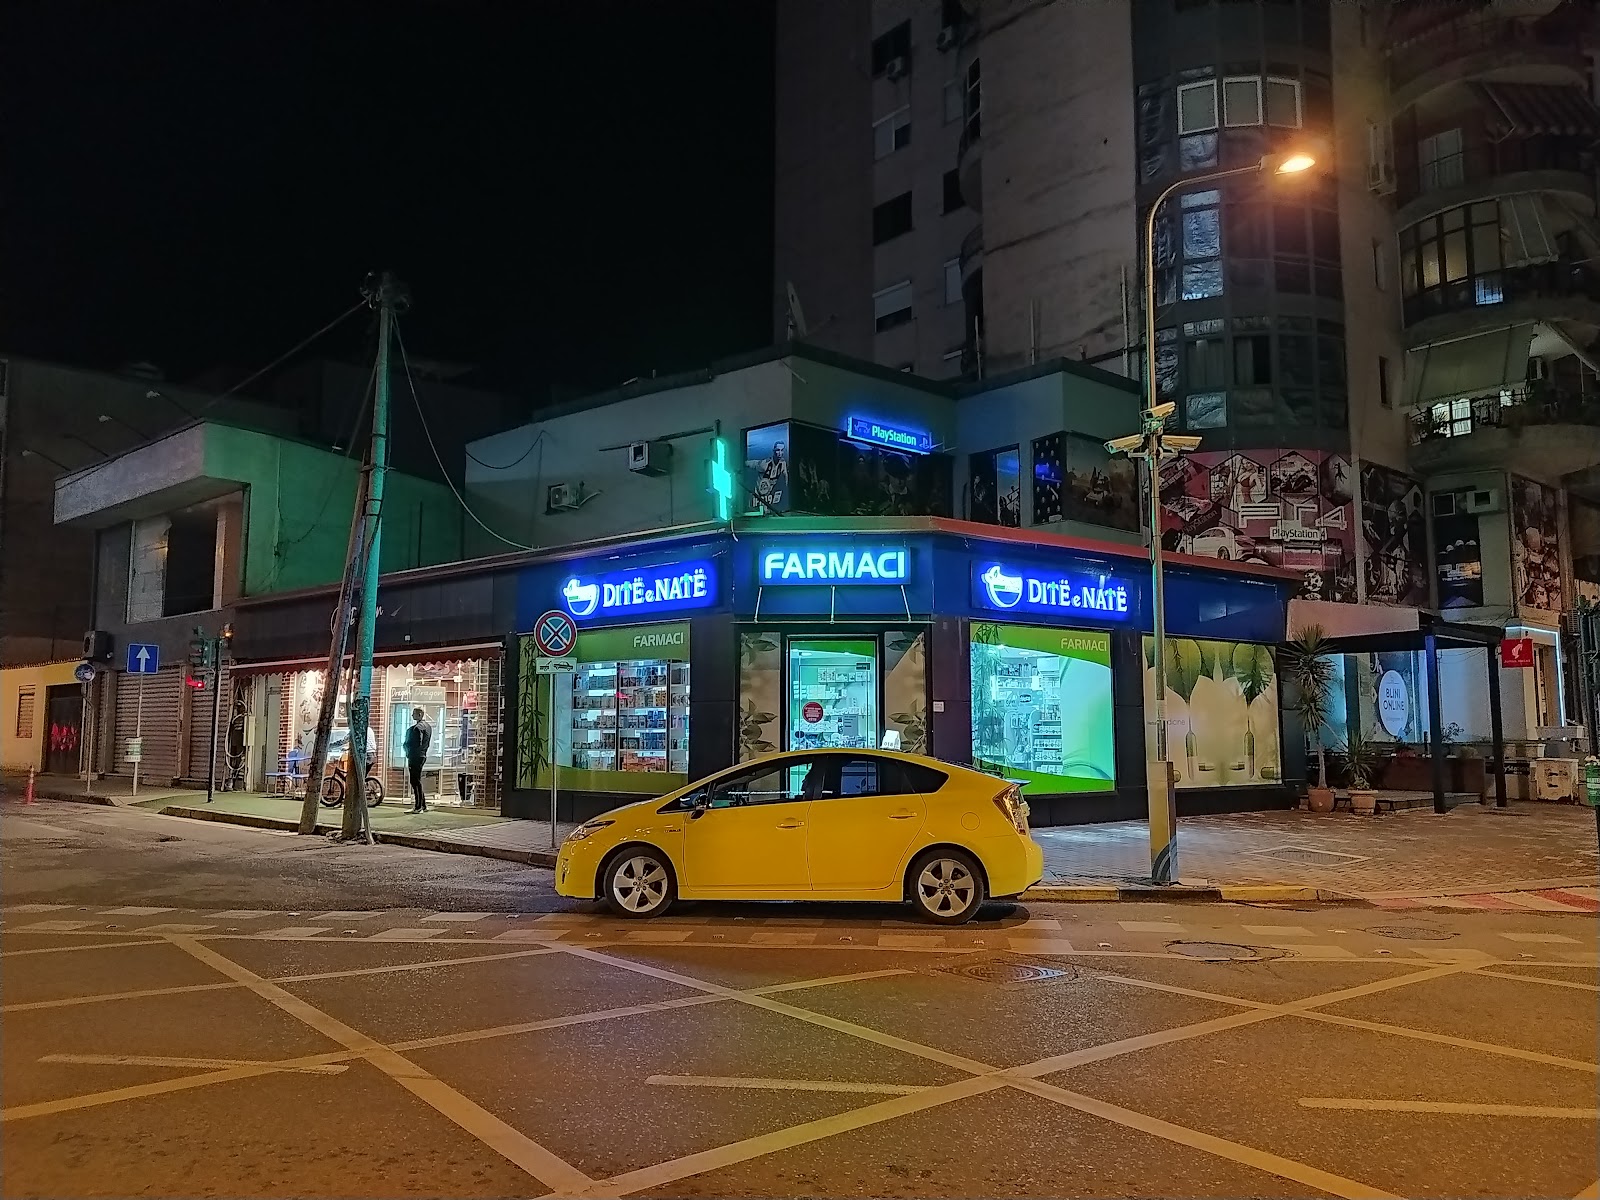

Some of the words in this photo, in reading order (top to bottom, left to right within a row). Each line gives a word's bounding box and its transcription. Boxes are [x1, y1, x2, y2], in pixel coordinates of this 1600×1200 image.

[871, 425, 917, 446] PlayStation
[1272, 528, 1318, 540] PlayStation
[764, 551, 905, 579] FARMACI
[602, 576, 645, 607] DITË
[655, 568, 707, 601] NATË
[1027, 579, 1070, 607] DITË
[1081, 586, 1128, 612] NATË
[633, 632, 684, 648] FARMACI
[1060, 638, 1107, 652] FARMACI
[1385, 688, 1401, 698] BLINI
[1382, 700, 1405, 711] ONLINE
